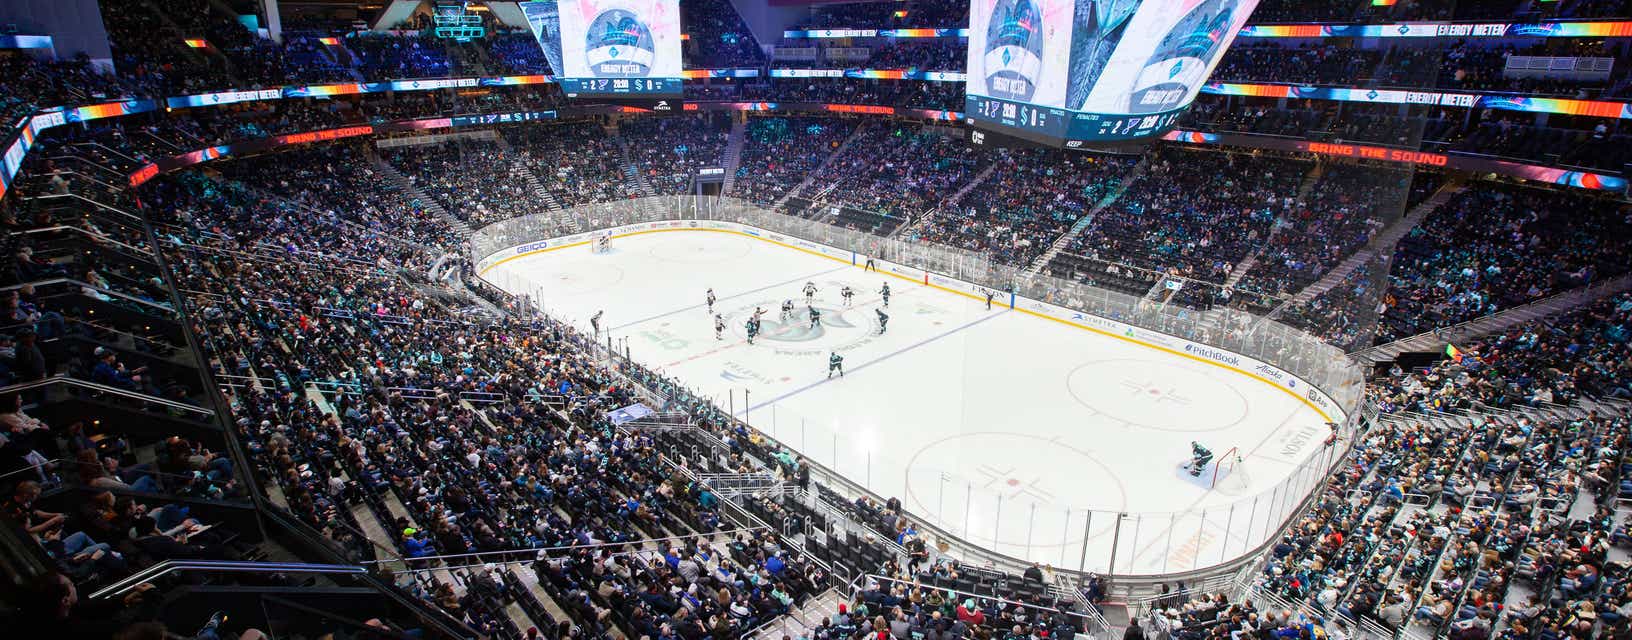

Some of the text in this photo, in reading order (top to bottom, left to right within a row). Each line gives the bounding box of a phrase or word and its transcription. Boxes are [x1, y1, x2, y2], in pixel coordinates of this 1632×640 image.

[1438, 24, 1506, 36] ENERGY METER
[1406, 92, 1475, 107] ENERGY METER
[871, 106, 894, 114] SOUND
[287, 126, 372, 144] BRING THE SOUND
[1309, 142, 1447, 166] BRING THE SOUND
[516, 242, 547, 254] GEICO
[1193, 346, 1240, 366] PitchBook
[1256, 364, 1283, 380] Alaska
